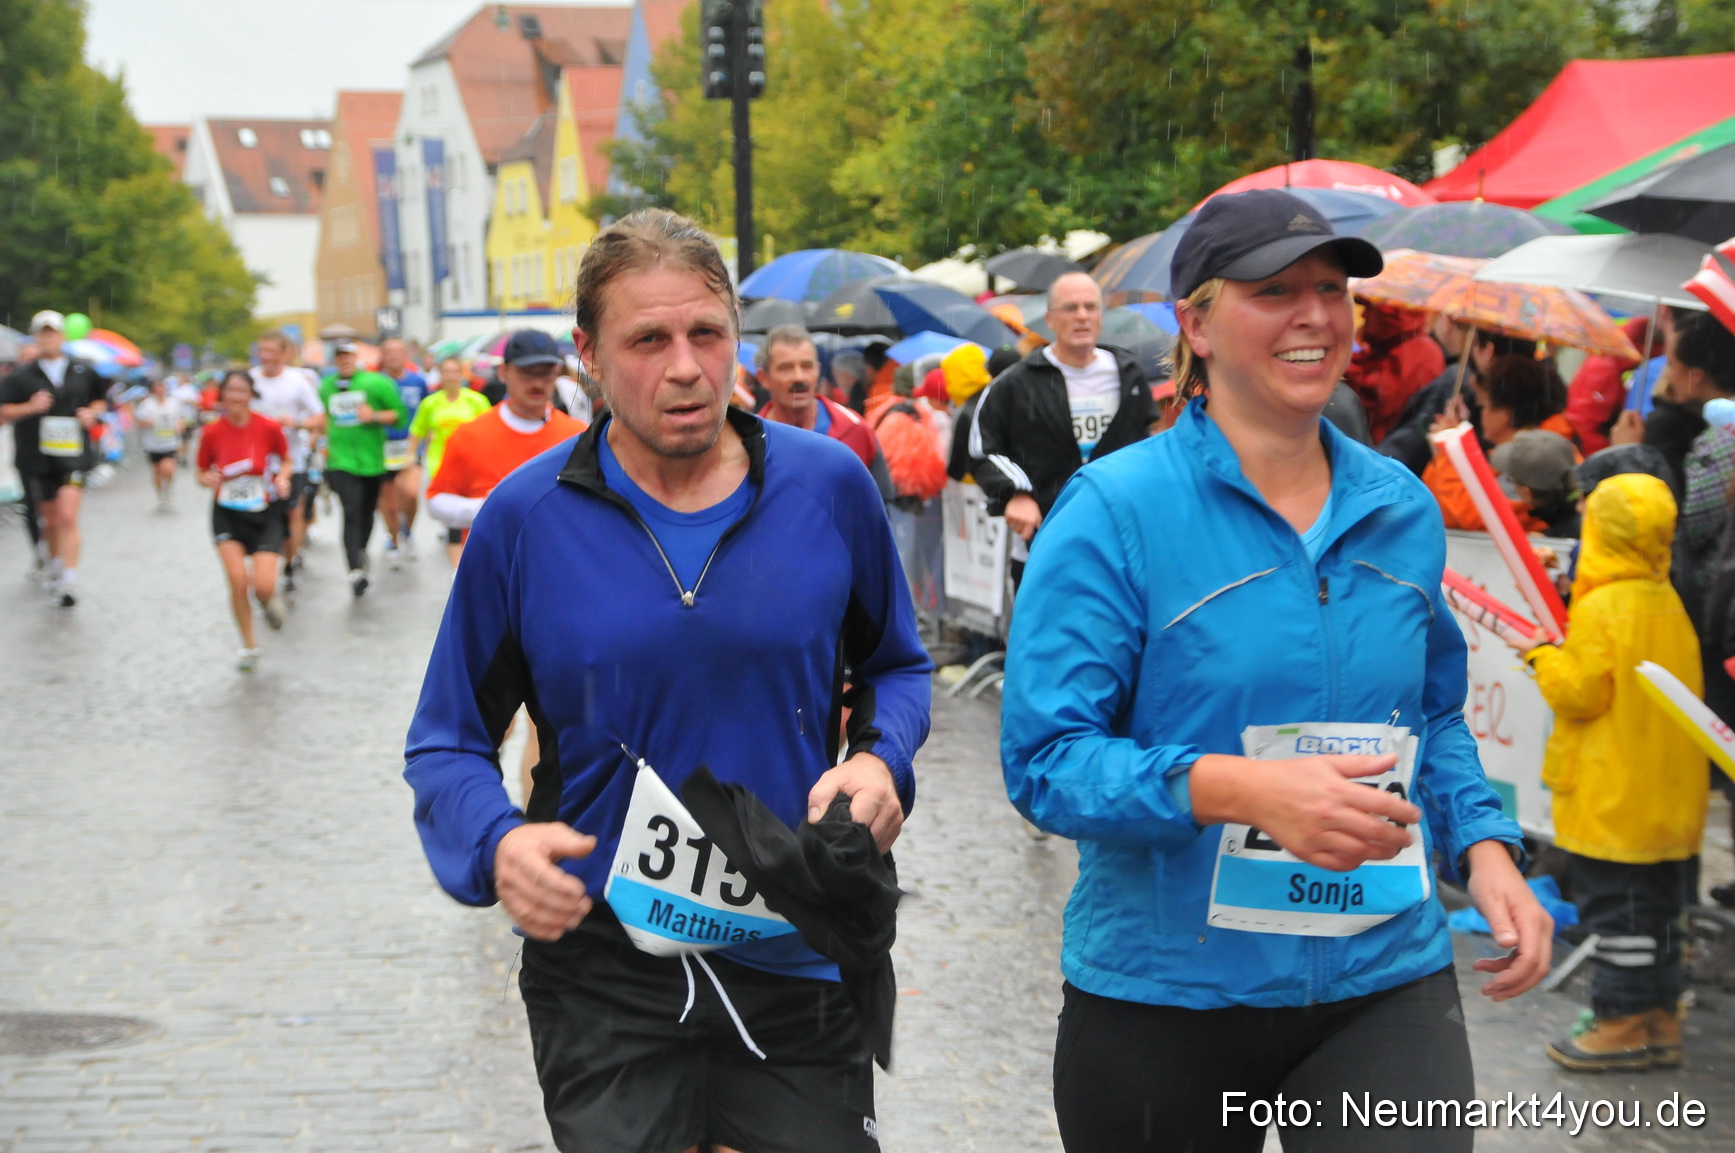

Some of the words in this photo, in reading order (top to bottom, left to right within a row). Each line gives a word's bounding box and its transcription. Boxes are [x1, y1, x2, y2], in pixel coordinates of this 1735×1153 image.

[1295, 735, 1383, 756] BOCK
[1288, 873, 1364, 912] Sonja
[647, 899, 762, 943] Matthias
